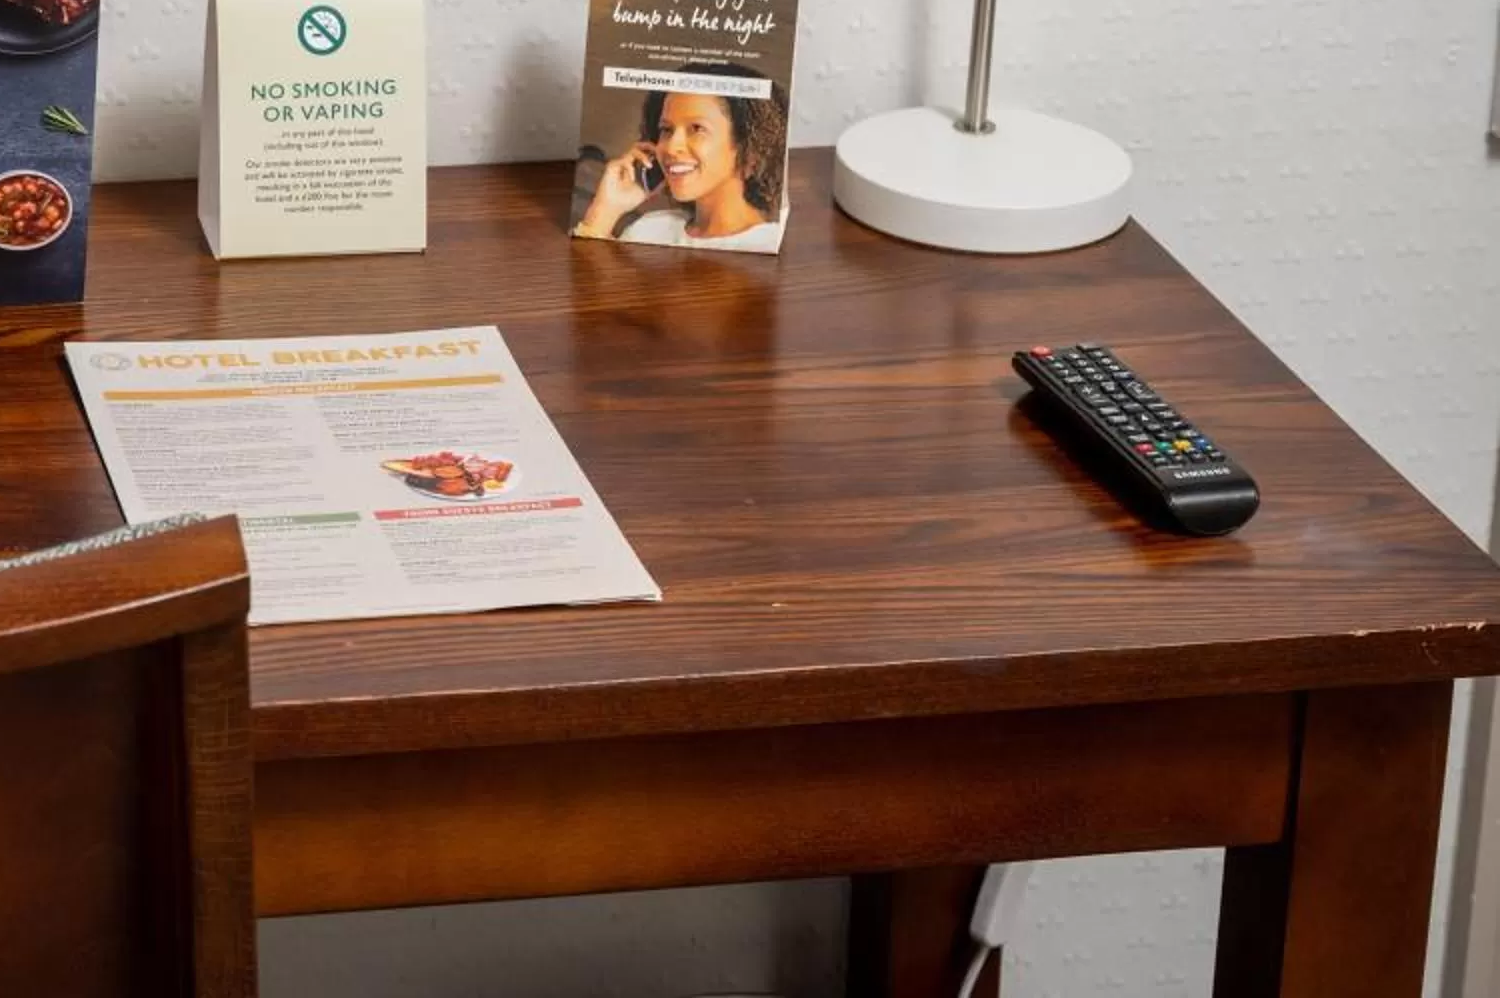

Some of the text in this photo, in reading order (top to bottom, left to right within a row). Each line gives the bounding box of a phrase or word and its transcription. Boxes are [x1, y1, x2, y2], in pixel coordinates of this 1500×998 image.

[612, 0, 776, 45] bump in the night
[614, 71, 675, 86] Telephone:
[250, 79, 397, 100] NO SMOKING
[263, 101, 384, 122] OR VAPING
[136, 353, 261, 370] HOTEL
[271, 339, 481, 365] BREAKFAST
